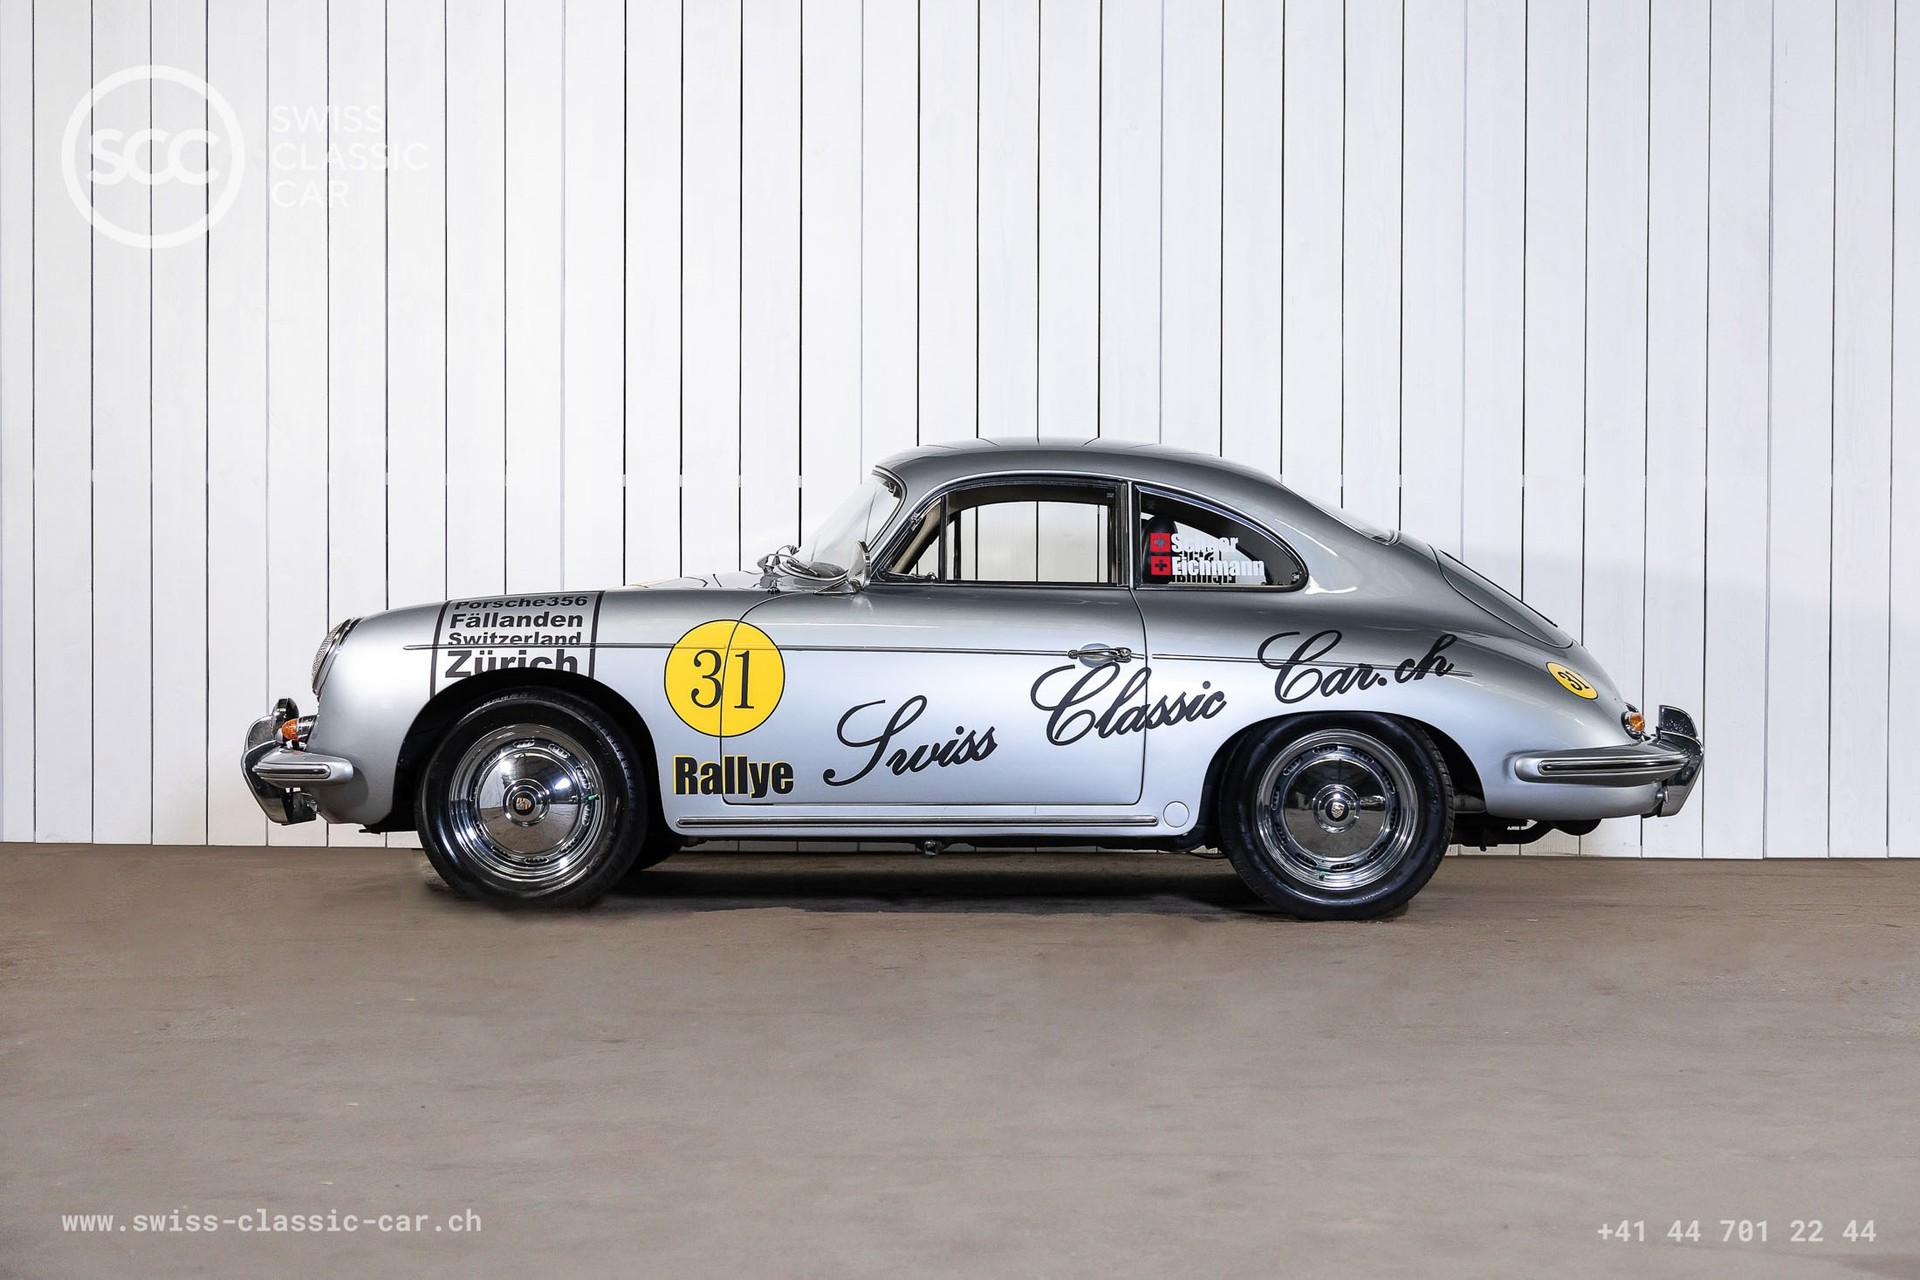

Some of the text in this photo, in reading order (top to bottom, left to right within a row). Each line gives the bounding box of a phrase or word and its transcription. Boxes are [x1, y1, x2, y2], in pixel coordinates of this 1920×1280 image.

[1171, 556, 1265, 576] Eichmann
[454, 596, 588, 610] Porsche356
[449, 611, 584, 629] Fällanden
[448, 631, 582, 646] Switzerland
[690, 648, 755, 710] 31
[1557, 670, 1591, 691] 31
[822, 629, 1455, 786] Swiss Classic Car.ch
[673, 755, 794, 799] Rallye
